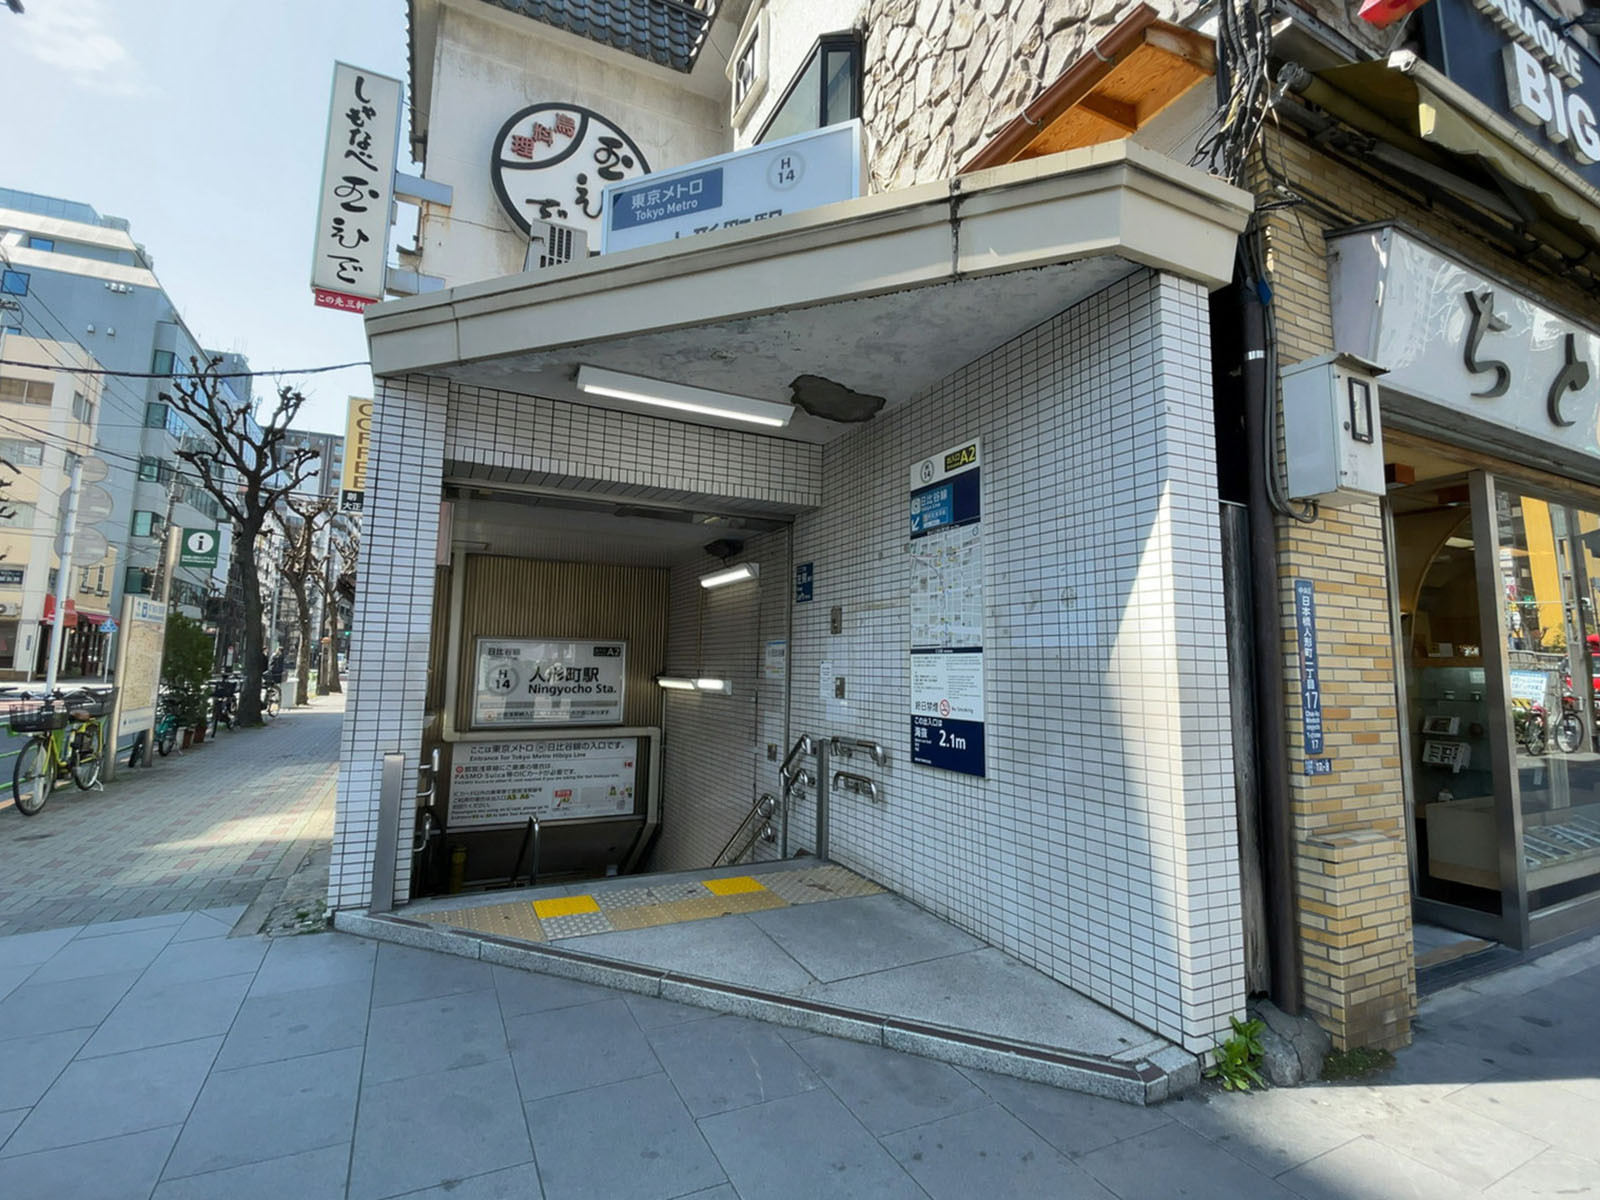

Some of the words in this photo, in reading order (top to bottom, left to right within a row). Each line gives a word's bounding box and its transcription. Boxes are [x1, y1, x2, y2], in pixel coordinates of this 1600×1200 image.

[1512, 41, 1600, 161] BIG
[781, 157, 790, 170] H
[778, 169, 795, 184] 14
[631, 178, 703, 210] 東京メトロ
[635, 206, 664, 221] Tokyo
[667, 199, 698, 214] Metro
[353, 403, 372, 489] COFFEE
[960, 446, 976, 464] A2
[1302, 595, 1315, 690] 日本橋人形町一丁目
[607, 648, 620, 656] A2
[499, 669, 508, 679] H
[529, 666, 600, 683] 人形町駅
[495, 679, 510, 690] 14
[528, 683, 592, 696] Ningyocho
[596, 683, 617, 694] Sta.
[1305, 692, 1318, 709] 17
[939, 730, 966, 750] 2.1m
[1311, 740, 1319, 750] 17
[470, 744, 534, 754] ここは東京メトロ
[454, 772, 482, 780] PASMO
